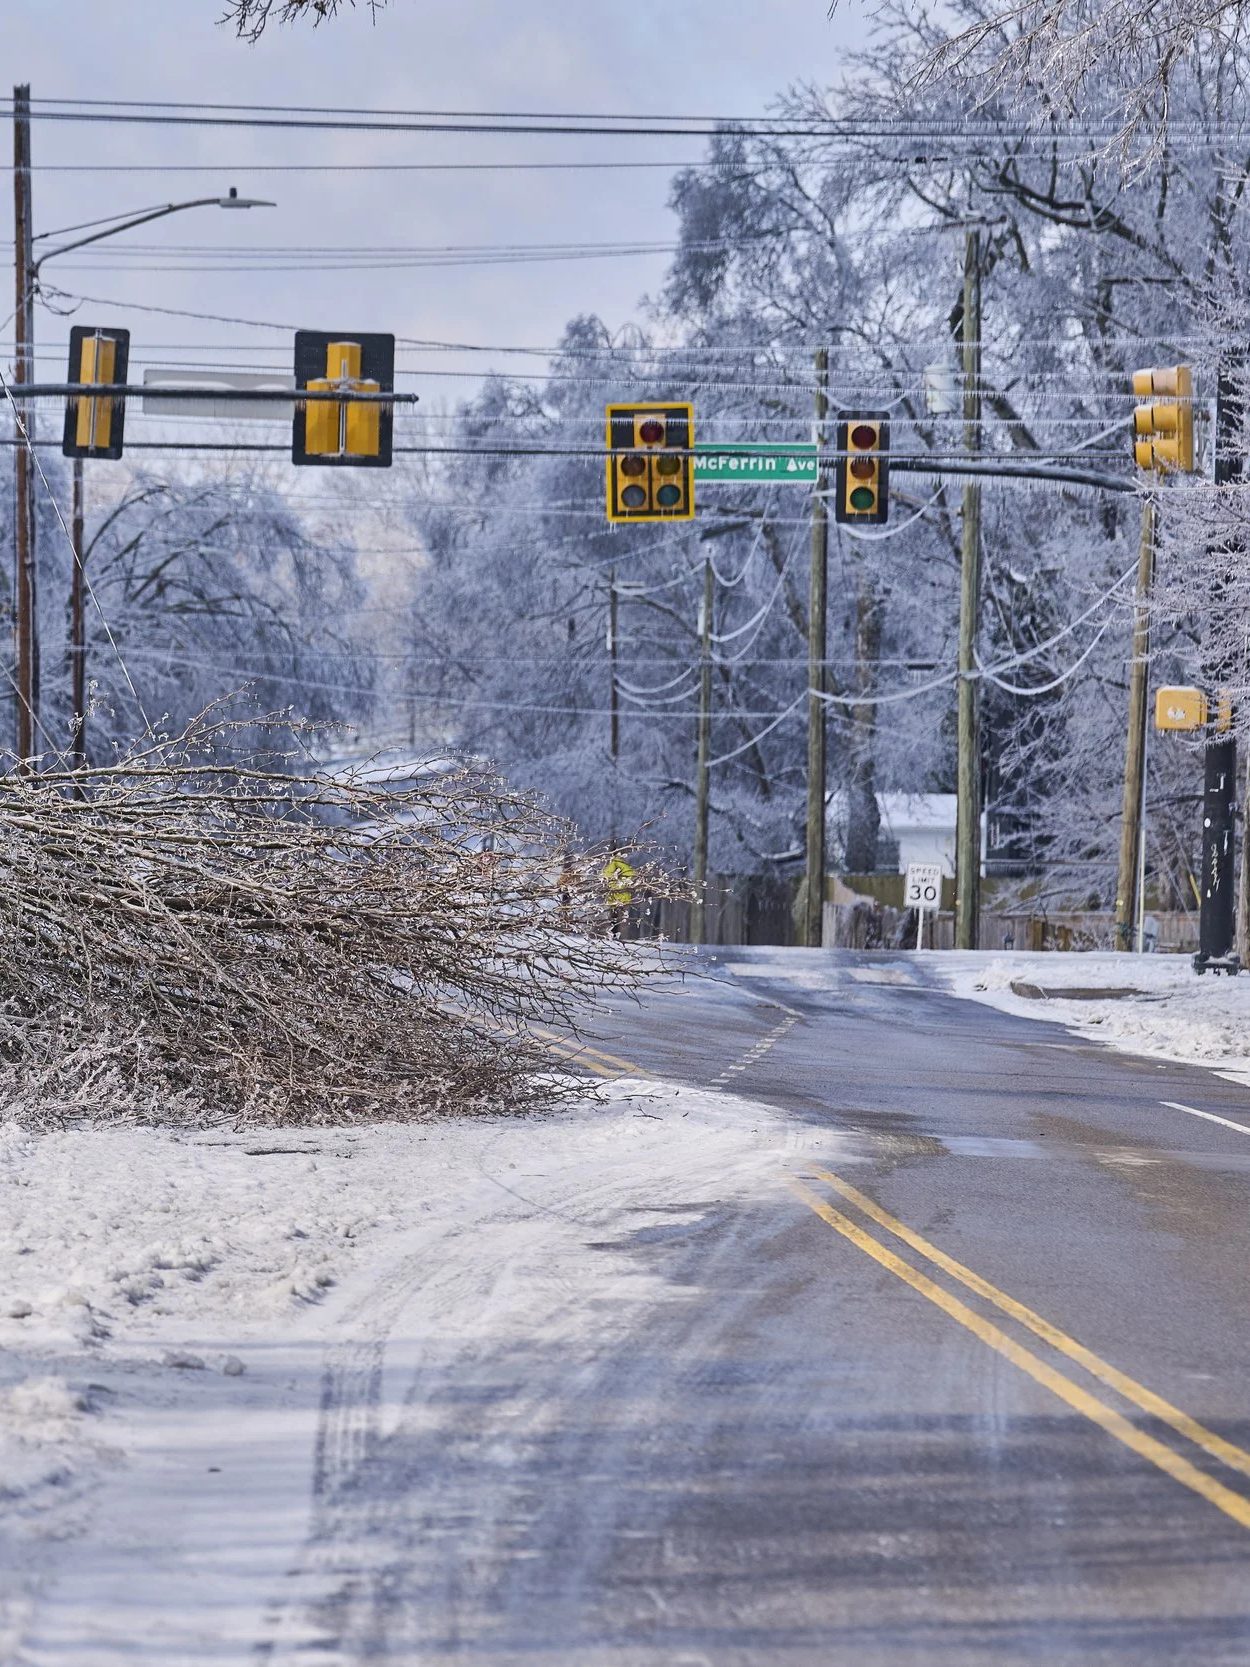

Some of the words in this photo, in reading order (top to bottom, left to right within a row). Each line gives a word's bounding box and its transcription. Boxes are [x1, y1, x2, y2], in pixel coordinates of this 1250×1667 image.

[693, 455, 776, 472] McFerrin
[786, 457, 815, 472] Ave
[910, 885, 937, 901] 30
